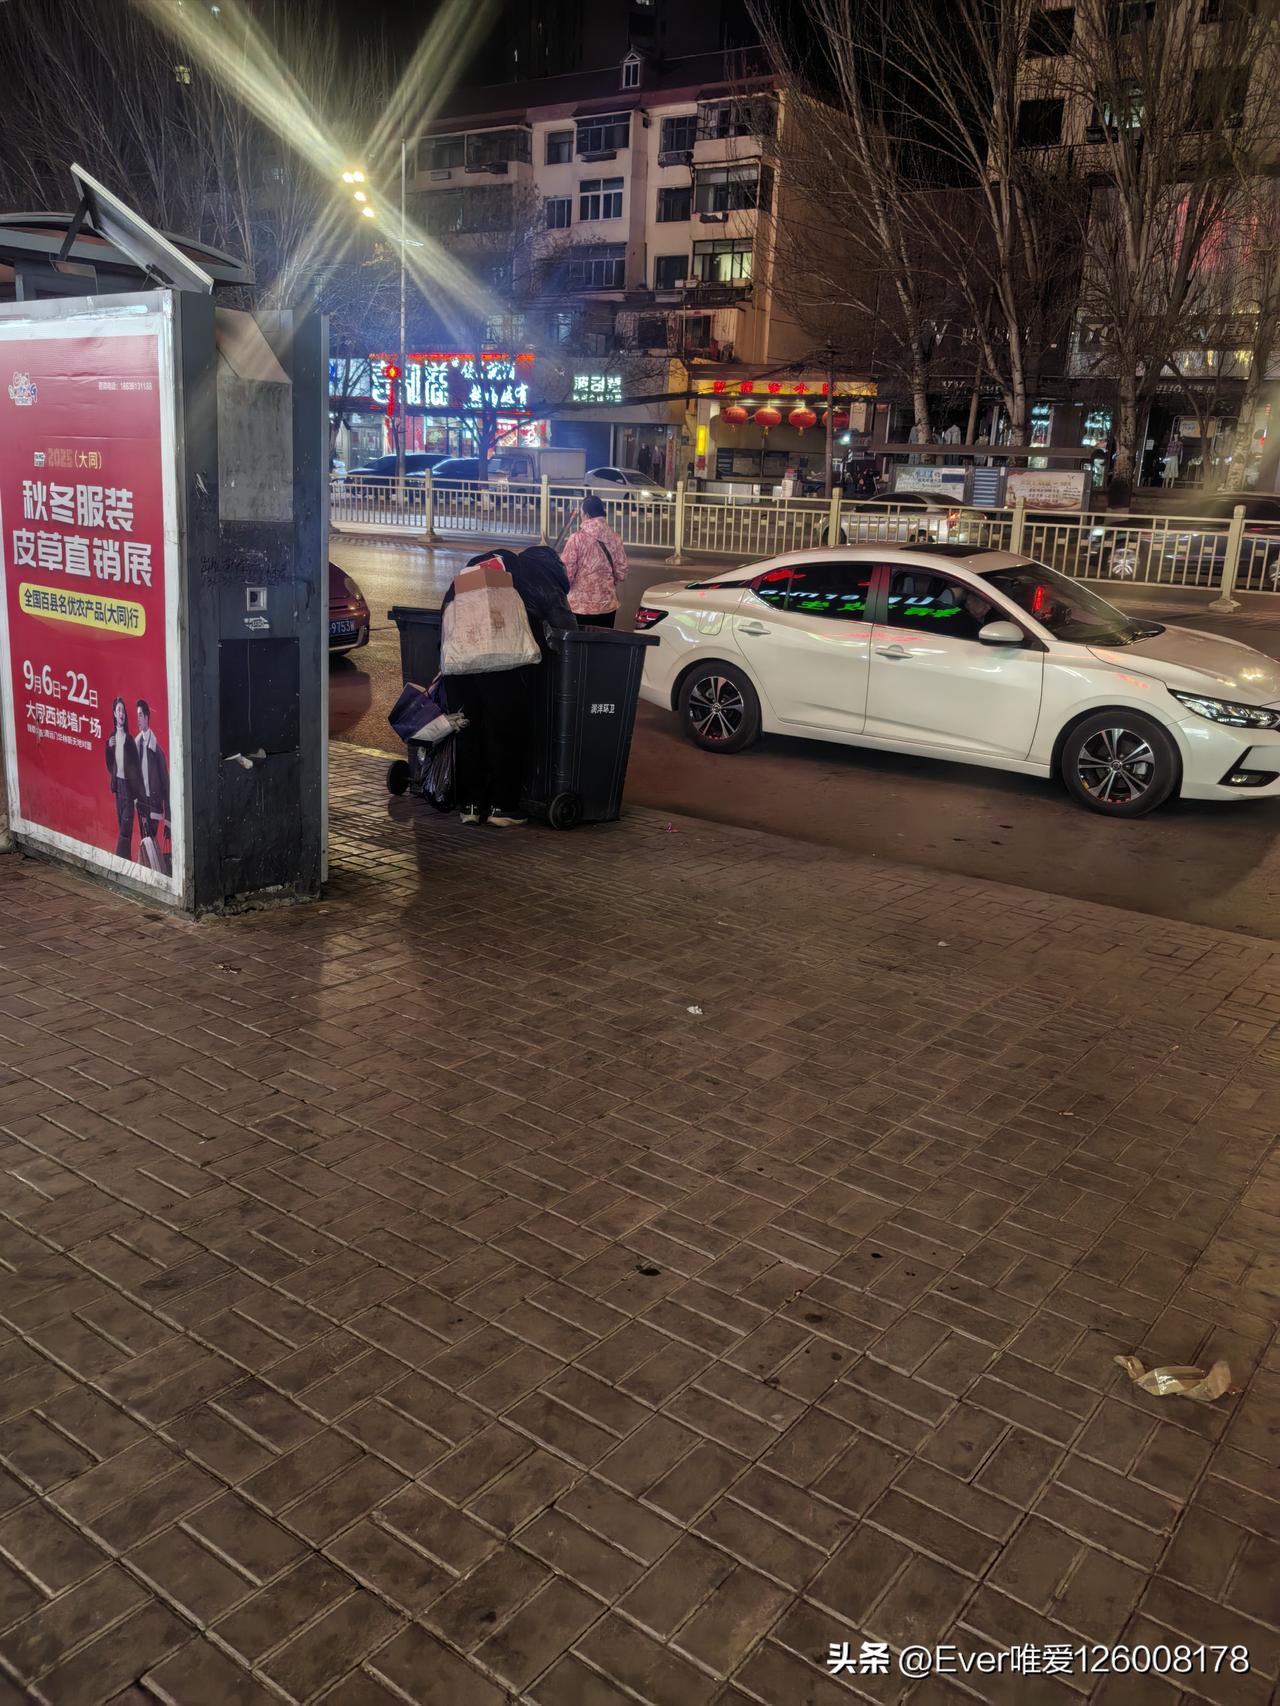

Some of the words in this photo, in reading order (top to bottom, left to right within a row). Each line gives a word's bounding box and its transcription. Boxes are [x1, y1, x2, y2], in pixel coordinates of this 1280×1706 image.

[22, 480, 134, 533] 秋冬服装
[12, 528, 153, 588] 皮草直销展
[24, 589, 140, 629] 全国百县名优农产品(大同)行
[23, 660, 98, 708] 9月6日-22日
[25, 700, 102, 739] 大同西城墙广场
